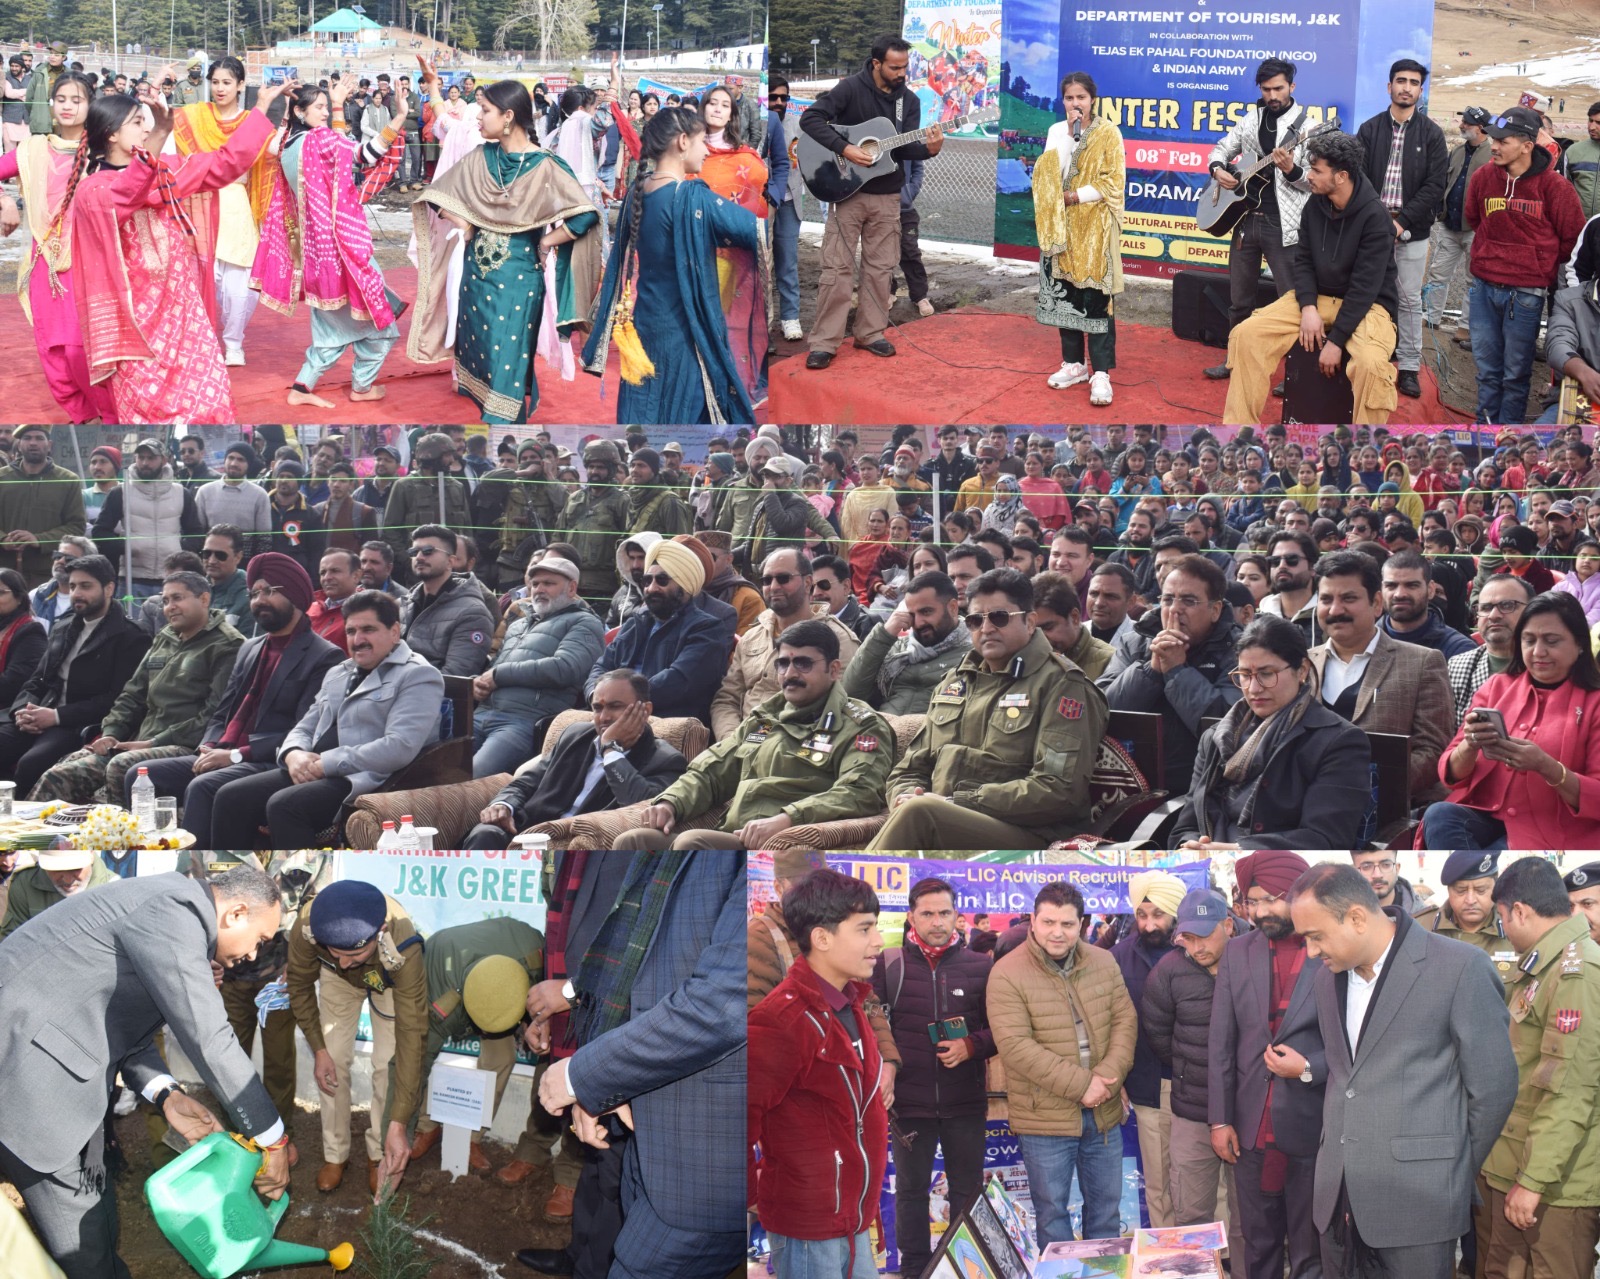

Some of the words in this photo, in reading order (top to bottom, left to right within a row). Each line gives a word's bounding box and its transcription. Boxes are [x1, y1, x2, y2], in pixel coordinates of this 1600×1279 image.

[1075, 10, 1184, 23] DEPARTMENT
[1188, 11, 1212, 23] OF
[1216, 12, 1302, 27] TOURISM,
[1306, 13, 1341, 26] J&K
[928, 19, 990, 50] Winter
[1159, 32, 1230, 41] COLLABORATION
[1091, 46, 1127, 56] TEJAS
[1129, 46, 1144, 57] EK
[1146, 47, 1188, 58] PAHAL
[1189, 48, 1276, 60] FOUNDATION
[1278, 51, 1318, 64] (NGO)
[1152, 63, 1161, 73] &
[1163, 64, 1207, 75] INDIAN
[1208, 65, 1247, 76] ARMY
[1166, 81, 1175, 89] IS
[1176, 82, 1229, 91] ORGANISING
[1067, 96, 1180, 129] INTER
[1168, 150, 1203, 167] Feb
[1484, 197, 1506, 217] LOUIS
[1122, 216, 1173, 230] CULTURAL
[1119, 239, 1146, 250] TALLS
[1188, 247, 1230, 259] DEPART
[1456, 432, 1470, 441] LIC
[394, 863, 448, 898] J&K
[457, 866, 543, 904] GREE
[967, 868, 996, 882] LIC
[1000, 869, 1065, 884] Advisor
[1069, 868, 1137, 884] Recruit
[957, 891, 978, 908] in
[986, 891, 1025, 909] LIC
